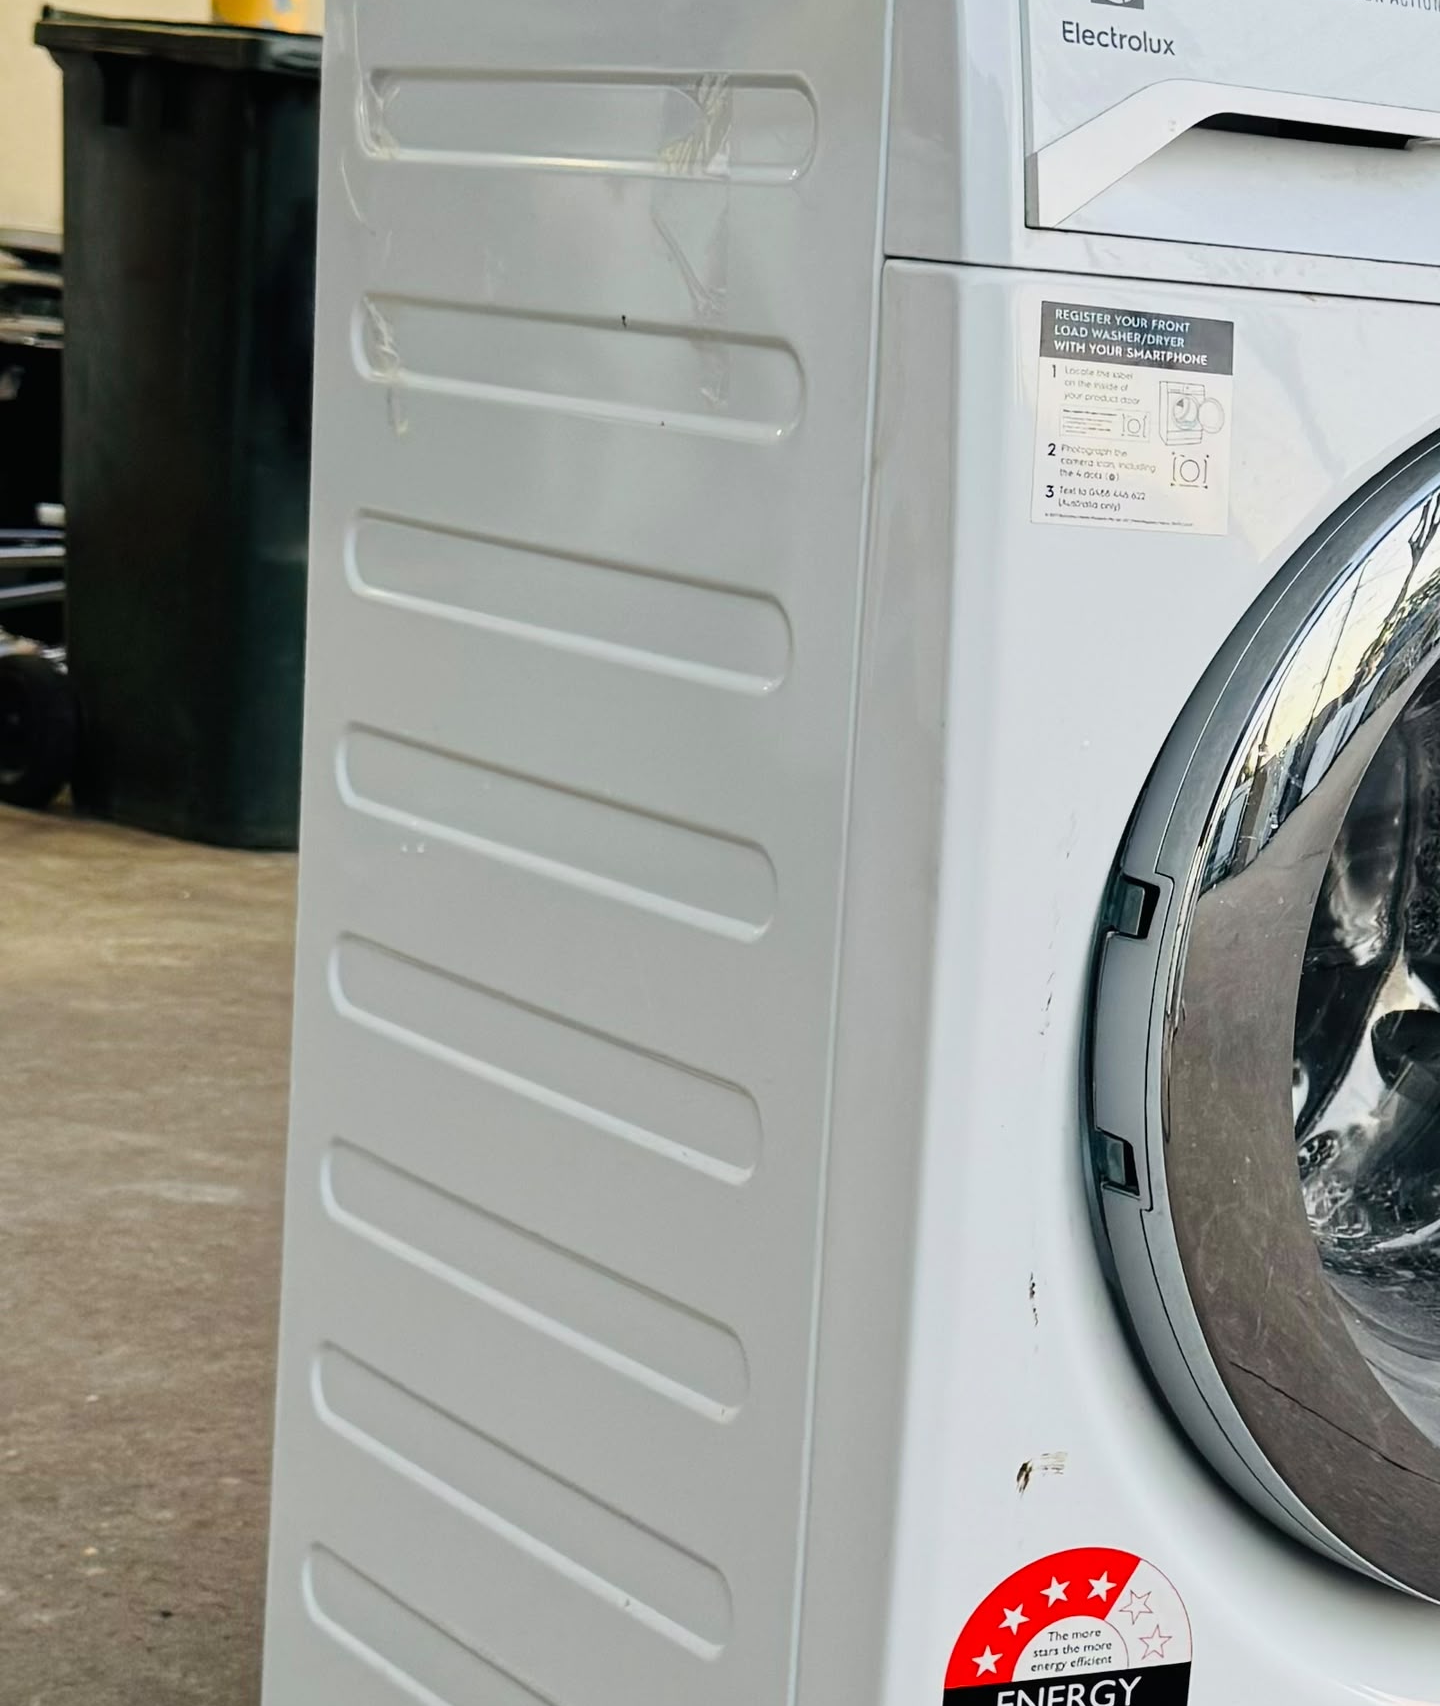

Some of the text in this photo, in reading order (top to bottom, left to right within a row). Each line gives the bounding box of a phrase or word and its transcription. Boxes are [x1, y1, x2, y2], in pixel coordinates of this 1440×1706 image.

[1062, 20, 1176, 56] Electrolux
[1055, 309, 1191, 333] REGISTER YOUR FRONT
[1054, 325, 1185, 348] LOAD WASHER/DRYER
[1054, 341, 1208, 366] WITH YOUR SMARTPHONE
[1052, 364, 1057, 378] 1
[1047, 443, 1056, 456] 2
[1045, 485, 1055, 498] 3
[1048, 1630, 1101, 1642] The more
[1033, 1642, 1112, 1658] stars the more
[1030, 1655, 1112, 1672] energy efficient
